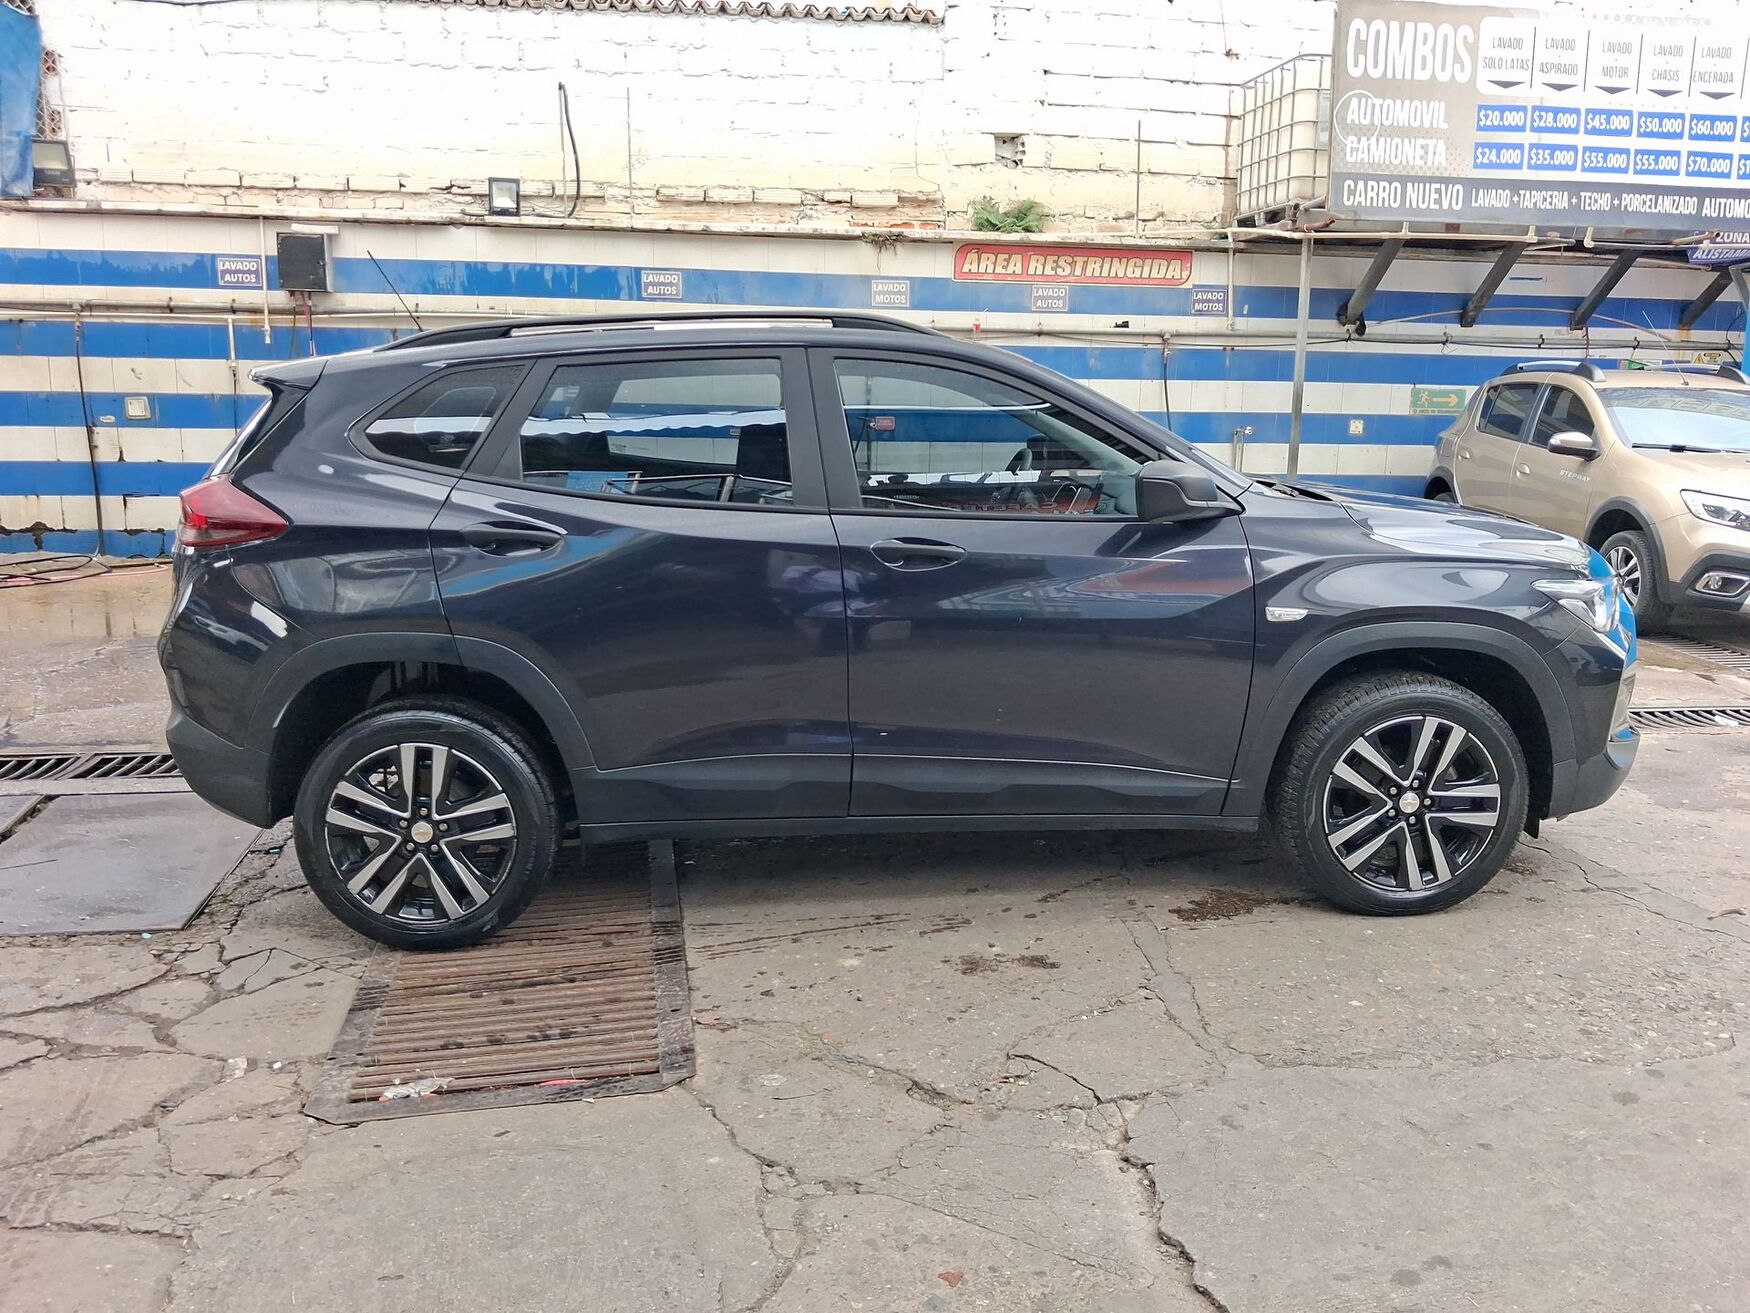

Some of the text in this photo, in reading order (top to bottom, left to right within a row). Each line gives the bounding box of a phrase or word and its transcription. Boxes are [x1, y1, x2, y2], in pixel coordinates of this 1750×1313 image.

[1492, 37, 1524, 50] LAVADO
[1545, 37, 1576, 51] LAVADO
[1602, 41, 1632, 55] LAVADO
[1347, 18, 1474, 83] COMBOS
[1653, 44, 1684, 57] LAVADO
[1701, 46, 1732, 59] LAVADO
[1483, 56, 1530, 71] SOLO LATAS
[1539, 62, 1578, 76] ASPIRADO
[1601, 65, 1629, 79] MOTOR
[1651, 68, 1680, 82] CHASIS
[1692, 70, 1734, 84] ENCERADA
[1346, 97, 1449, 129] AUTOMOVIL
[1479, 109, 1525, 127] $20.000
[1533, 110, 1578, 129] $28.000
[1586, 112, 1630, 131] $45.000
[1639, 115, 1683, 134] $50.000
[1690, 118, 1734, 137] $60.000
[1345, 135, 1447, 167] CAMIONETA
[1476, 145, 1521, 165] $24.000
[1530, 148, 1575, 166] $35.000
[1583, 150, 1627, 168] $55.000
[1635, 153, 1679, 171] $55.000
[1687, 155, 1731, 173] $70.000
[1342, 179, 1402, 208] CARRO
[1405, 182, 1464, 210] NUEVO
[1471, 188, 1510, 208] LAVADO
[1580, 191, 1611, 211] TECHO
[1621, 193, 1698, 215] PORCELANIZADO
[220, 261, 257, 271] LAVADO
[961, 248, 1182, 280] ÁREA RESTRINGIDA
[224, 273, 256, 283] AUTOS
[644, 274, 679, 283] LAVADO
[647, 285, 677, 295] AUTOS
[873, 283, 906, 292] LAVADO
[1034, 288, 1065, 297] LAVADO
[875, 294, 906, 303] MOTOS
[1193, 291, 1224, 300] LAVADO
[1036, 299, 1064, 308] AUTOS
[1194, 302, 1223, 311] MOTOS
